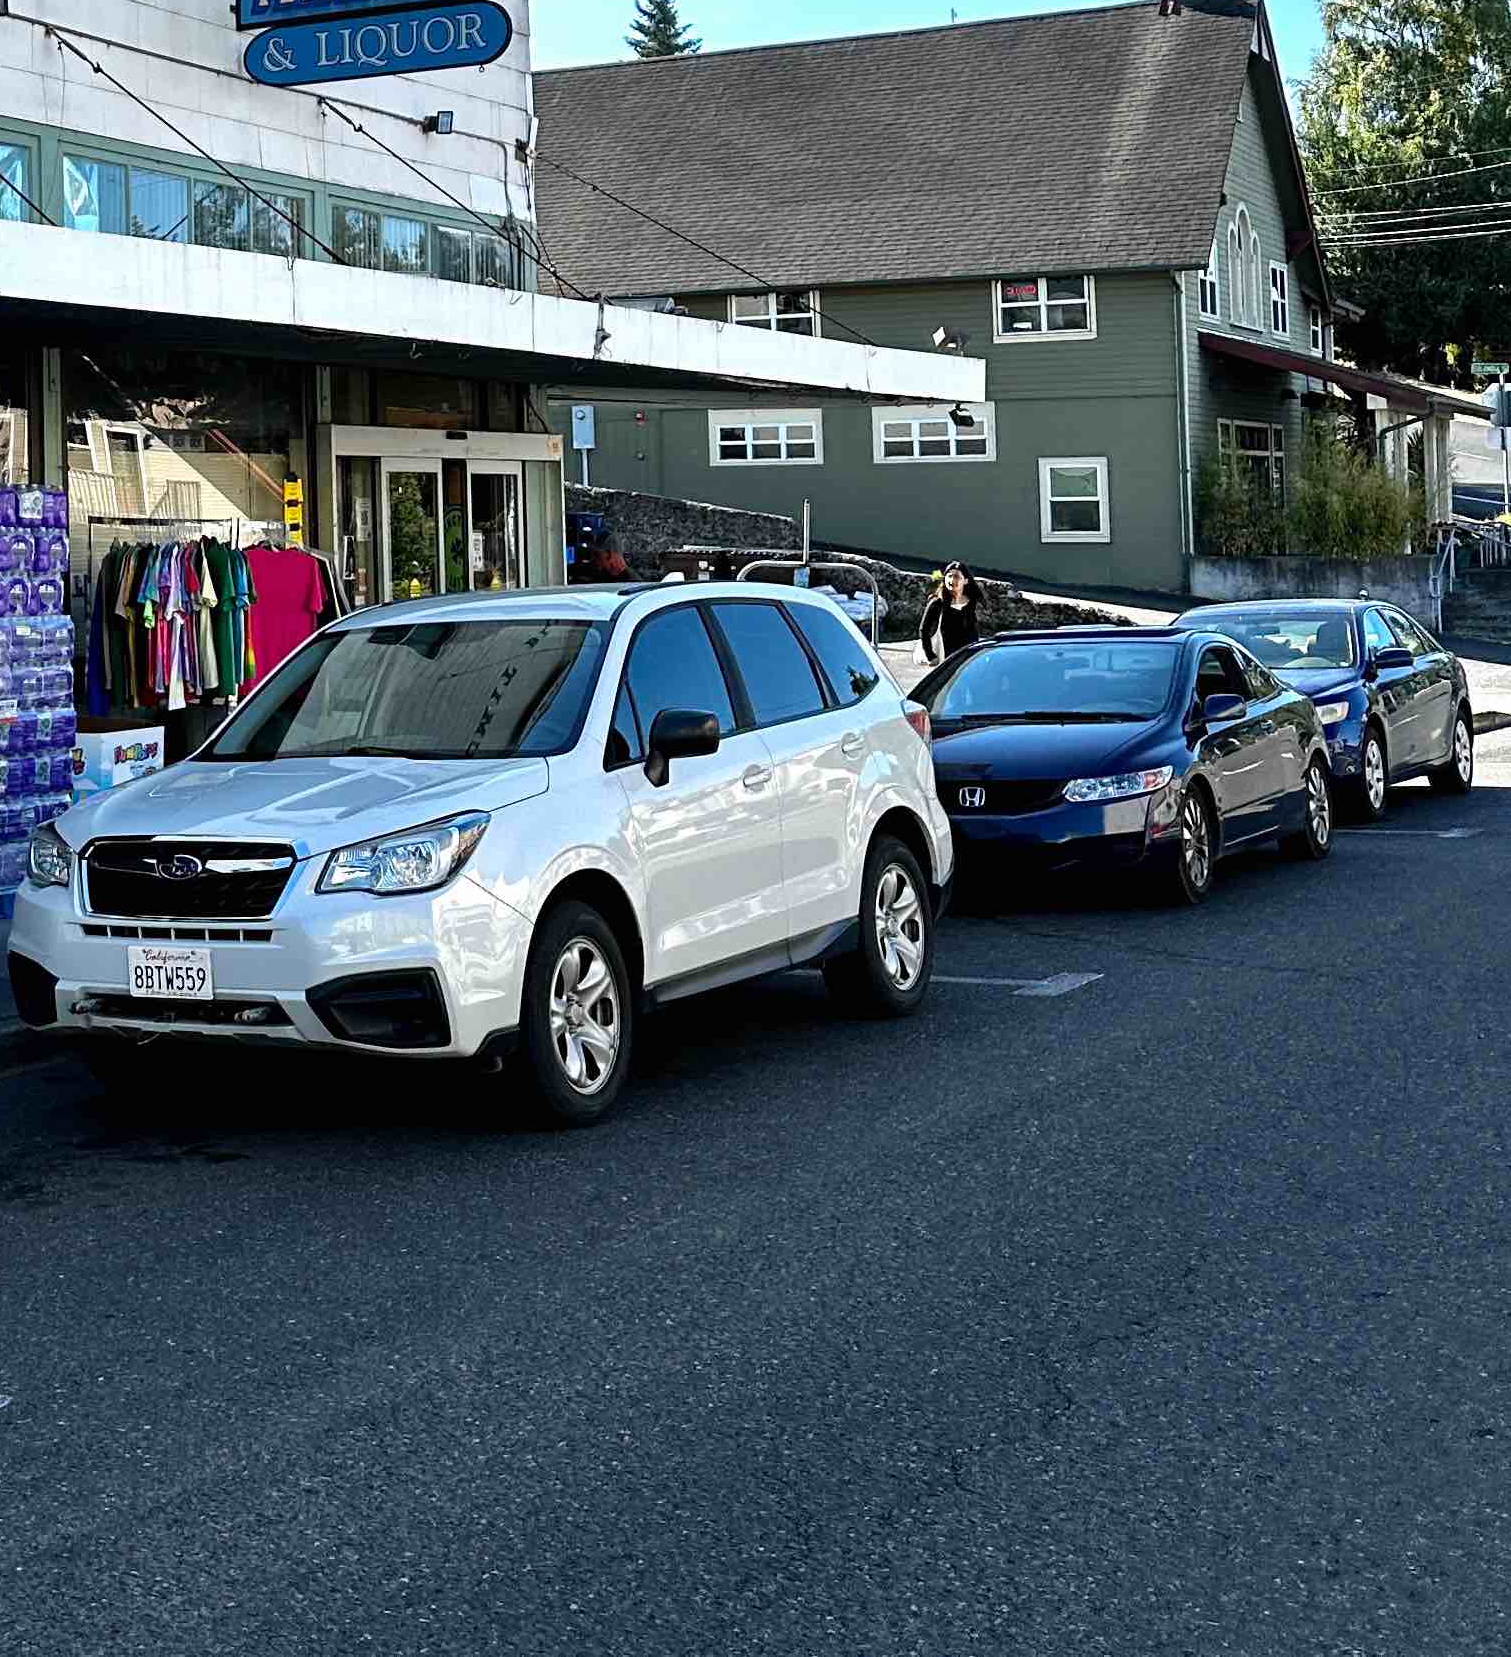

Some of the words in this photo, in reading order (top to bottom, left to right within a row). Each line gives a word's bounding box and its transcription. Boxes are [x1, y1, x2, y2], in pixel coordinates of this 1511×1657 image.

[263, 37, 297, 72] &
[317, 13, 487, 67] LIQUOR
[134, 965, 207, 992] 8BTW559
